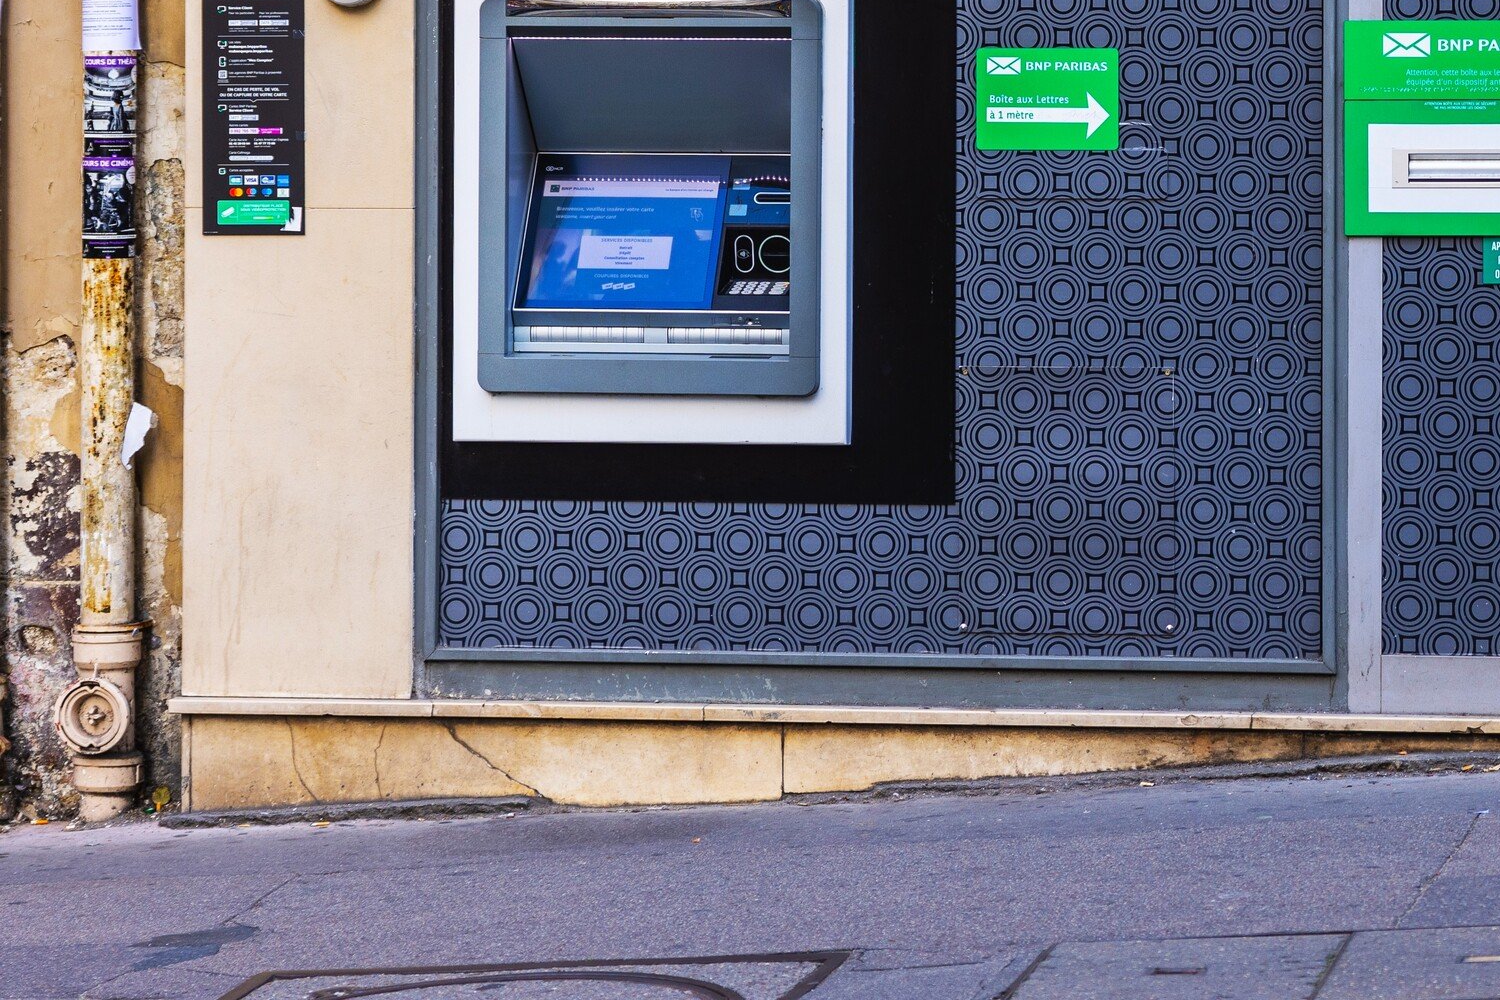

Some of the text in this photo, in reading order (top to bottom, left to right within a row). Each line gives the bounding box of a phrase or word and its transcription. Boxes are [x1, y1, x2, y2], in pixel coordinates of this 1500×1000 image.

[1438, 39, 1473, 51] BNP
[1026, 62, 1107, 71] BNP PARIBAS
[1406, 78, 1434, 86] équipée
[1454, 78, 1487, 86] dispositif
[990, 95, 1013, 103] Boîte
[990, 111, 1034, 119] à 1 mètre
